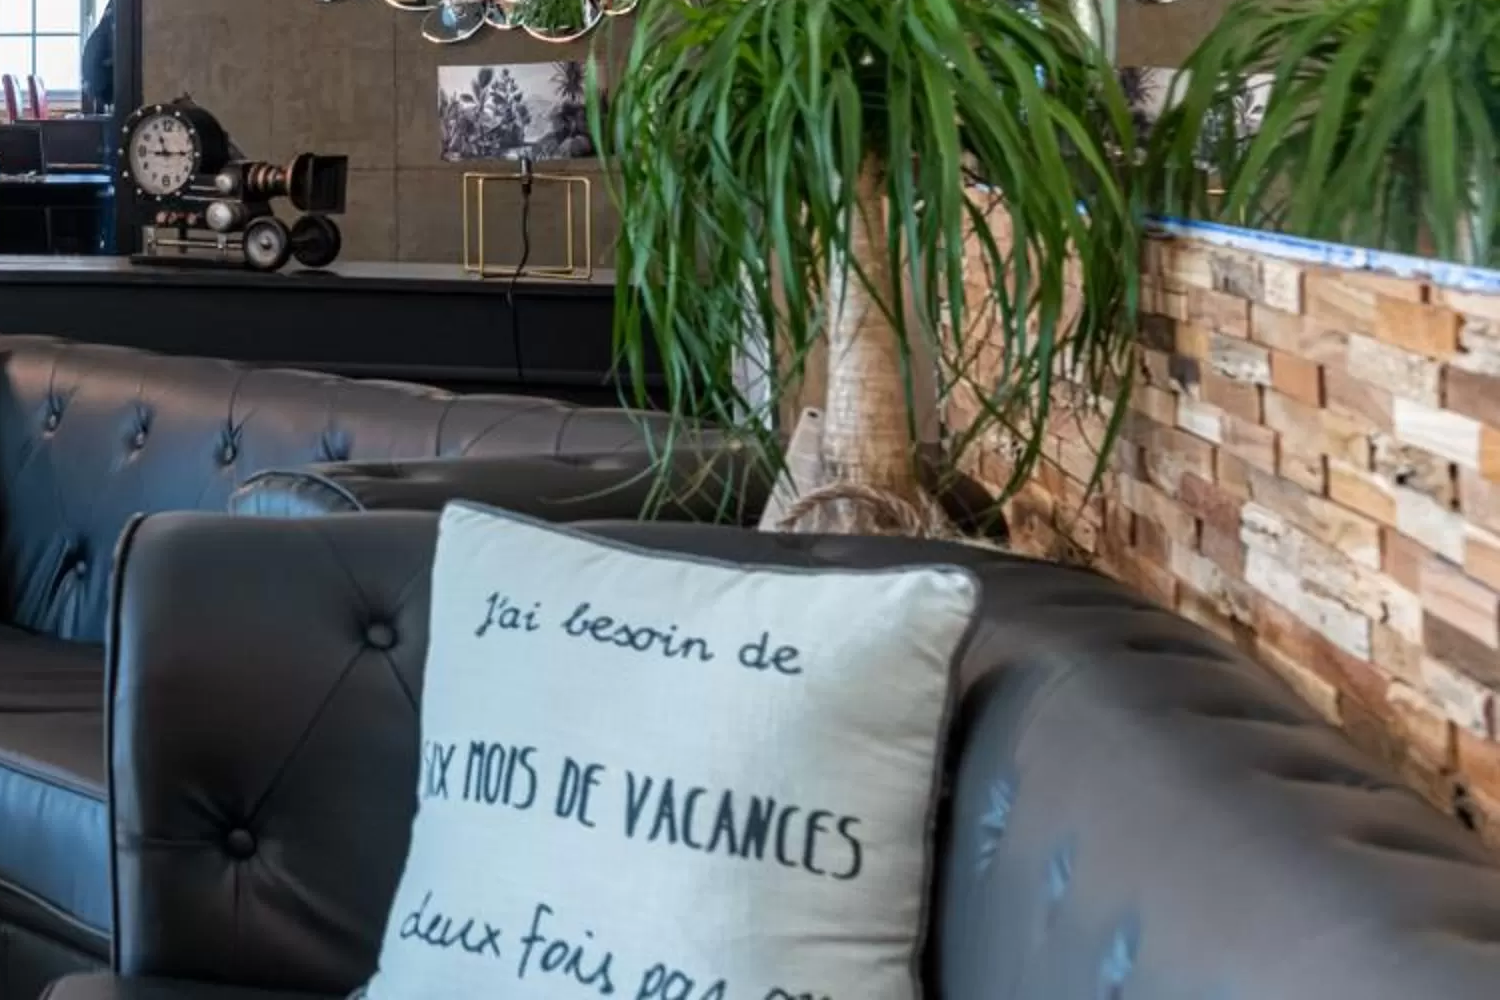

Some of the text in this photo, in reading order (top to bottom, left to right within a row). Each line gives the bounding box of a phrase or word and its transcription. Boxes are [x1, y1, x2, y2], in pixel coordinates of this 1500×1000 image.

[560, 602, 716, 662] besoin
[738, 631, 804, 676] de
[462, 739, 539, 811] MOIS
[554, 756, 607, 829] DE
[624, 769, 865, 882] VACANCES
[399, 890, 503, 957] deux
[516, 902, 616, 998] fois
